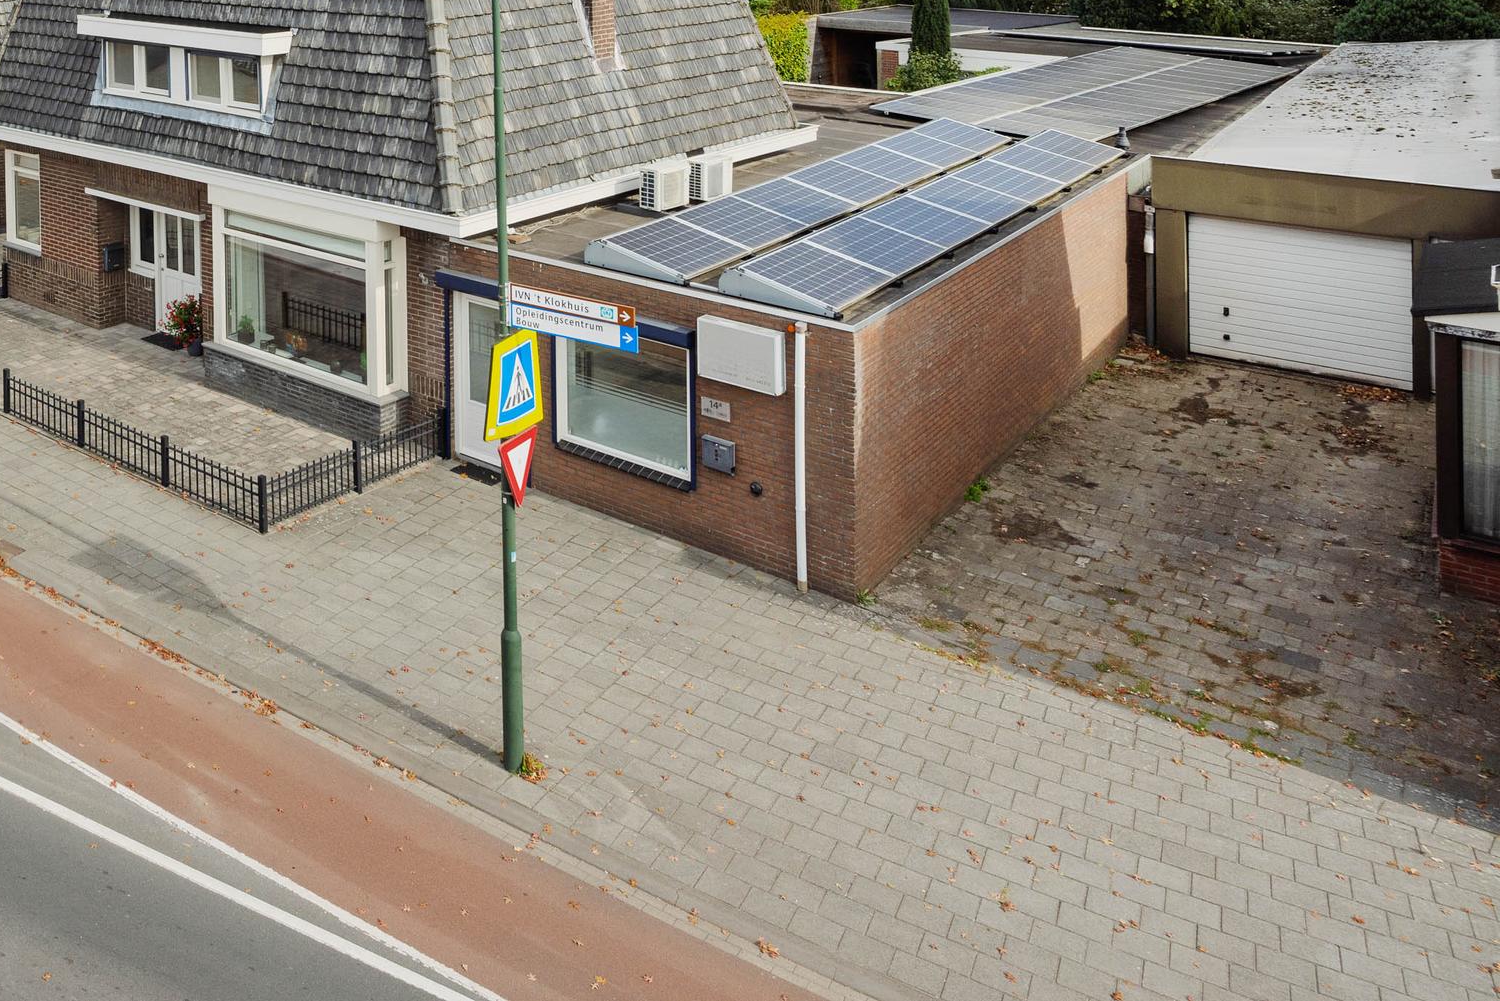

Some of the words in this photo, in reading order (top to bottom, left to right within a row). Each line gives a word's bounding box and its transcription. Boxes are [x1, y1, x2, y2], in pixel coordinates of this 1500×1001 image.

[515, 289, 531, 301] IVN
[545, 296, 590, 314] Klokhuis
[515, 307, 604, 333] Opleidingscentrum
[516, 317, 541, 329] Bouw
